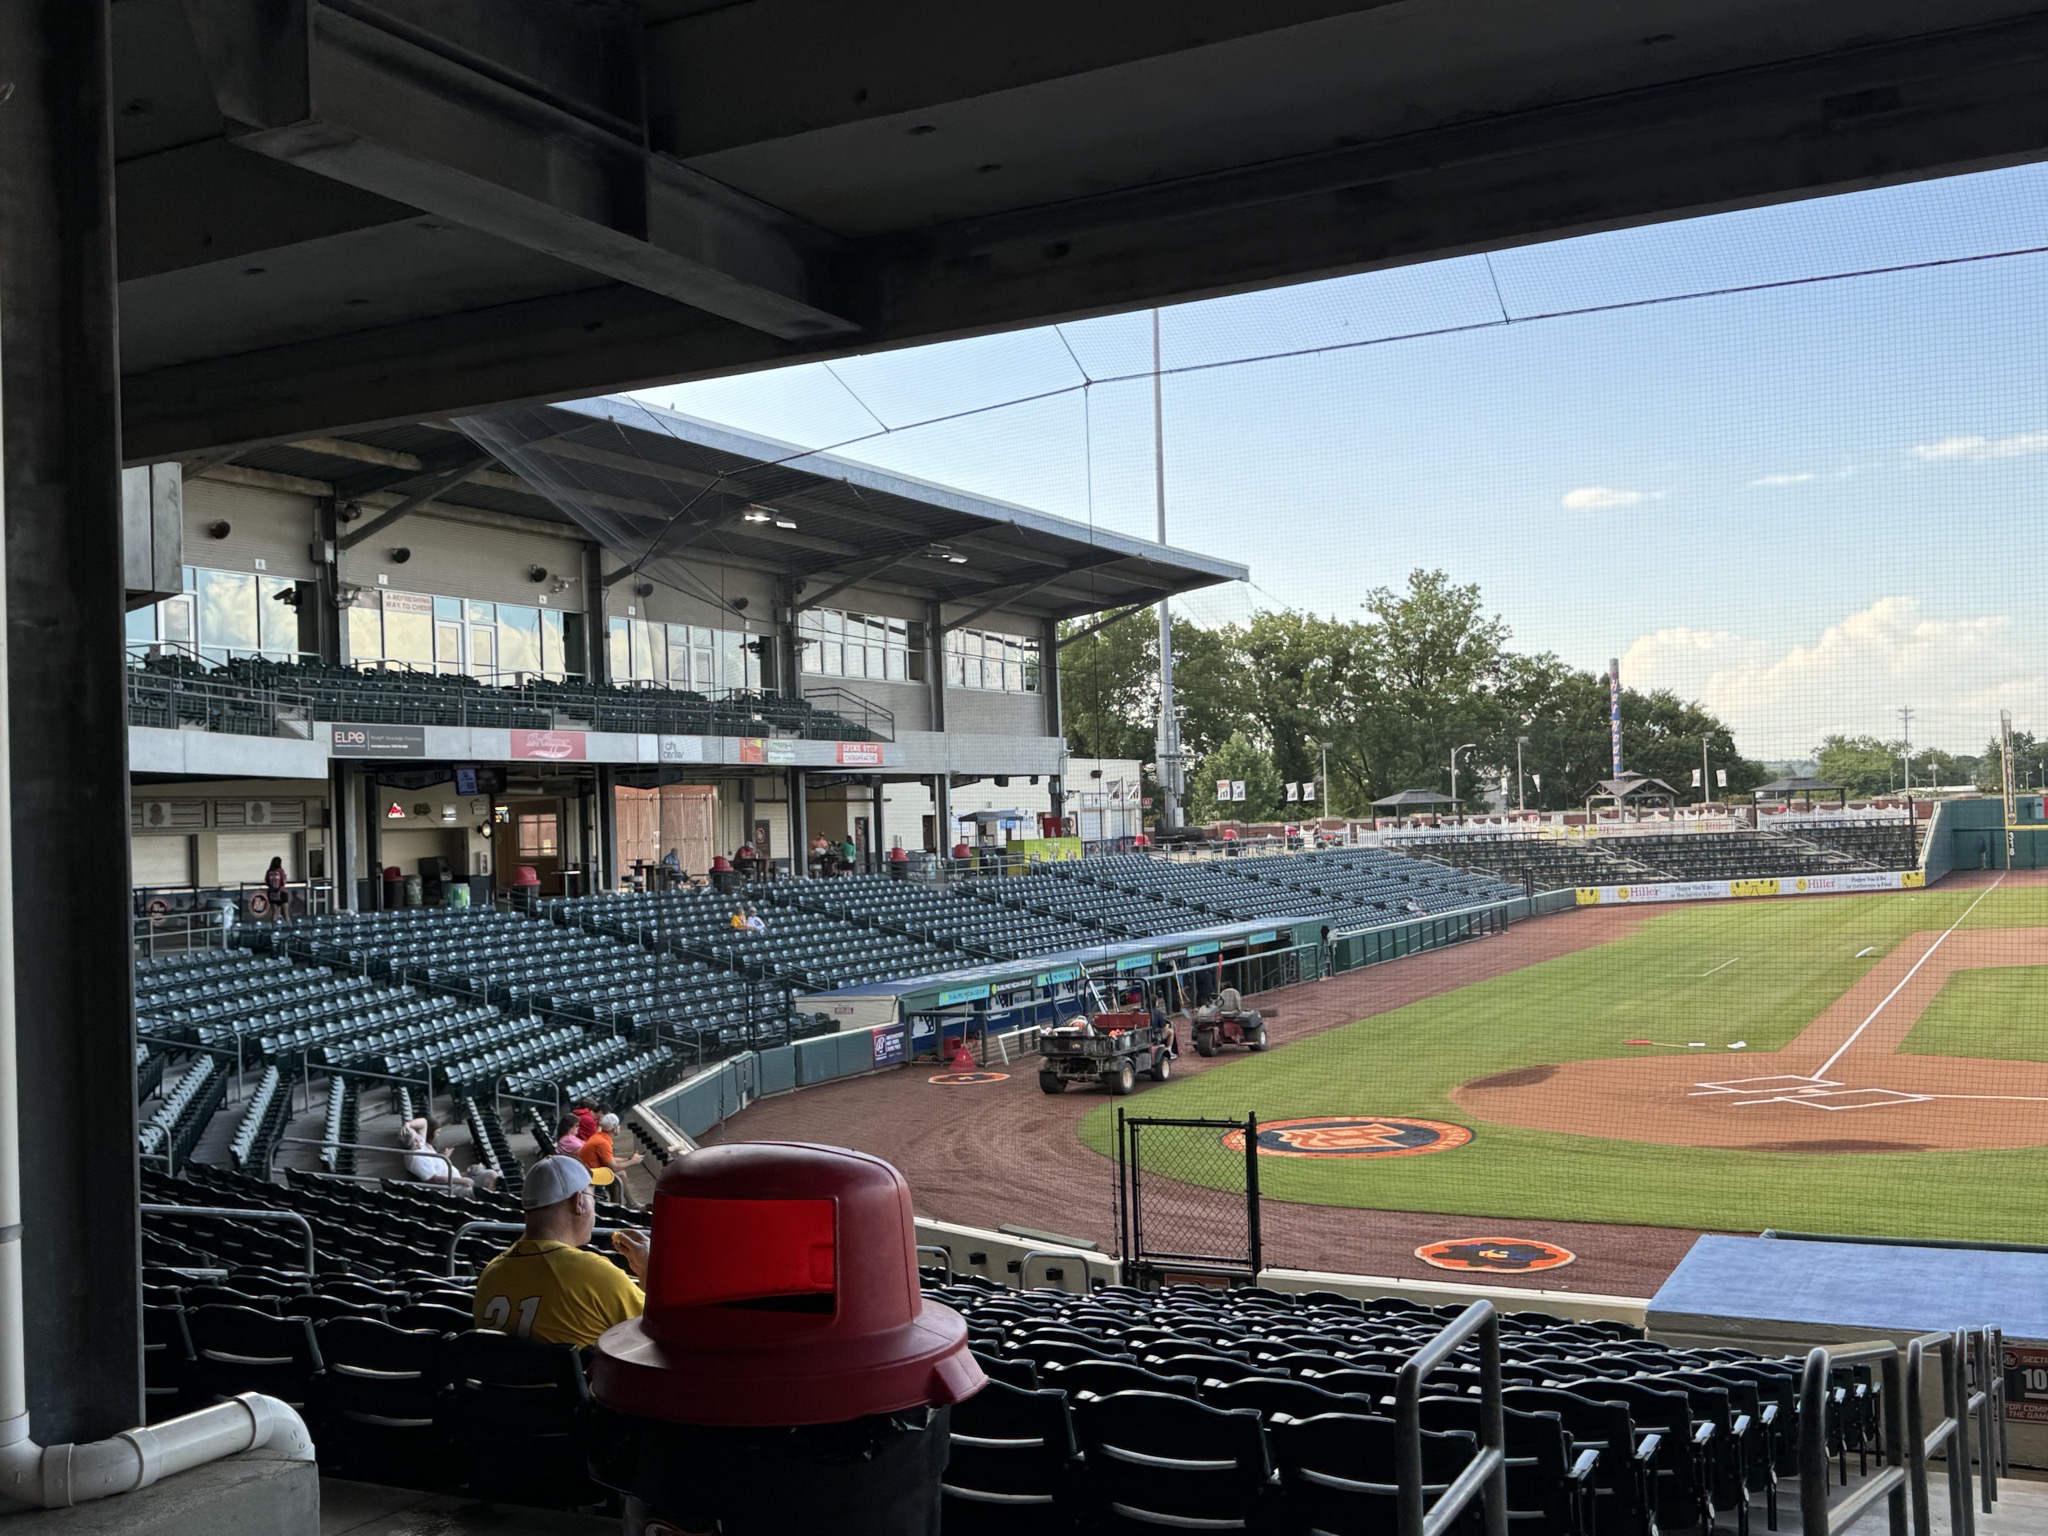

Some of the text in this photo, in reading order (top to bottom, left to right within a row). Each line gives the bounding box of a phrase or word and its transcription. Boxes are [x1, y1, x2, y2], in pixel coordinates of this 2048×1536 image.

[334, 731, 365, 744] ELPO
[1808, 879, 1835, 889] Hiller
[1630, 886, 1660, 898] Hiller
[483, 1295, 542, 1337] 21
[2022, 1355, 2048, 1364] SECTI
[2022, 1368, 2048, 1390] 10
[2009, 1410, 2025, 1418] THE
